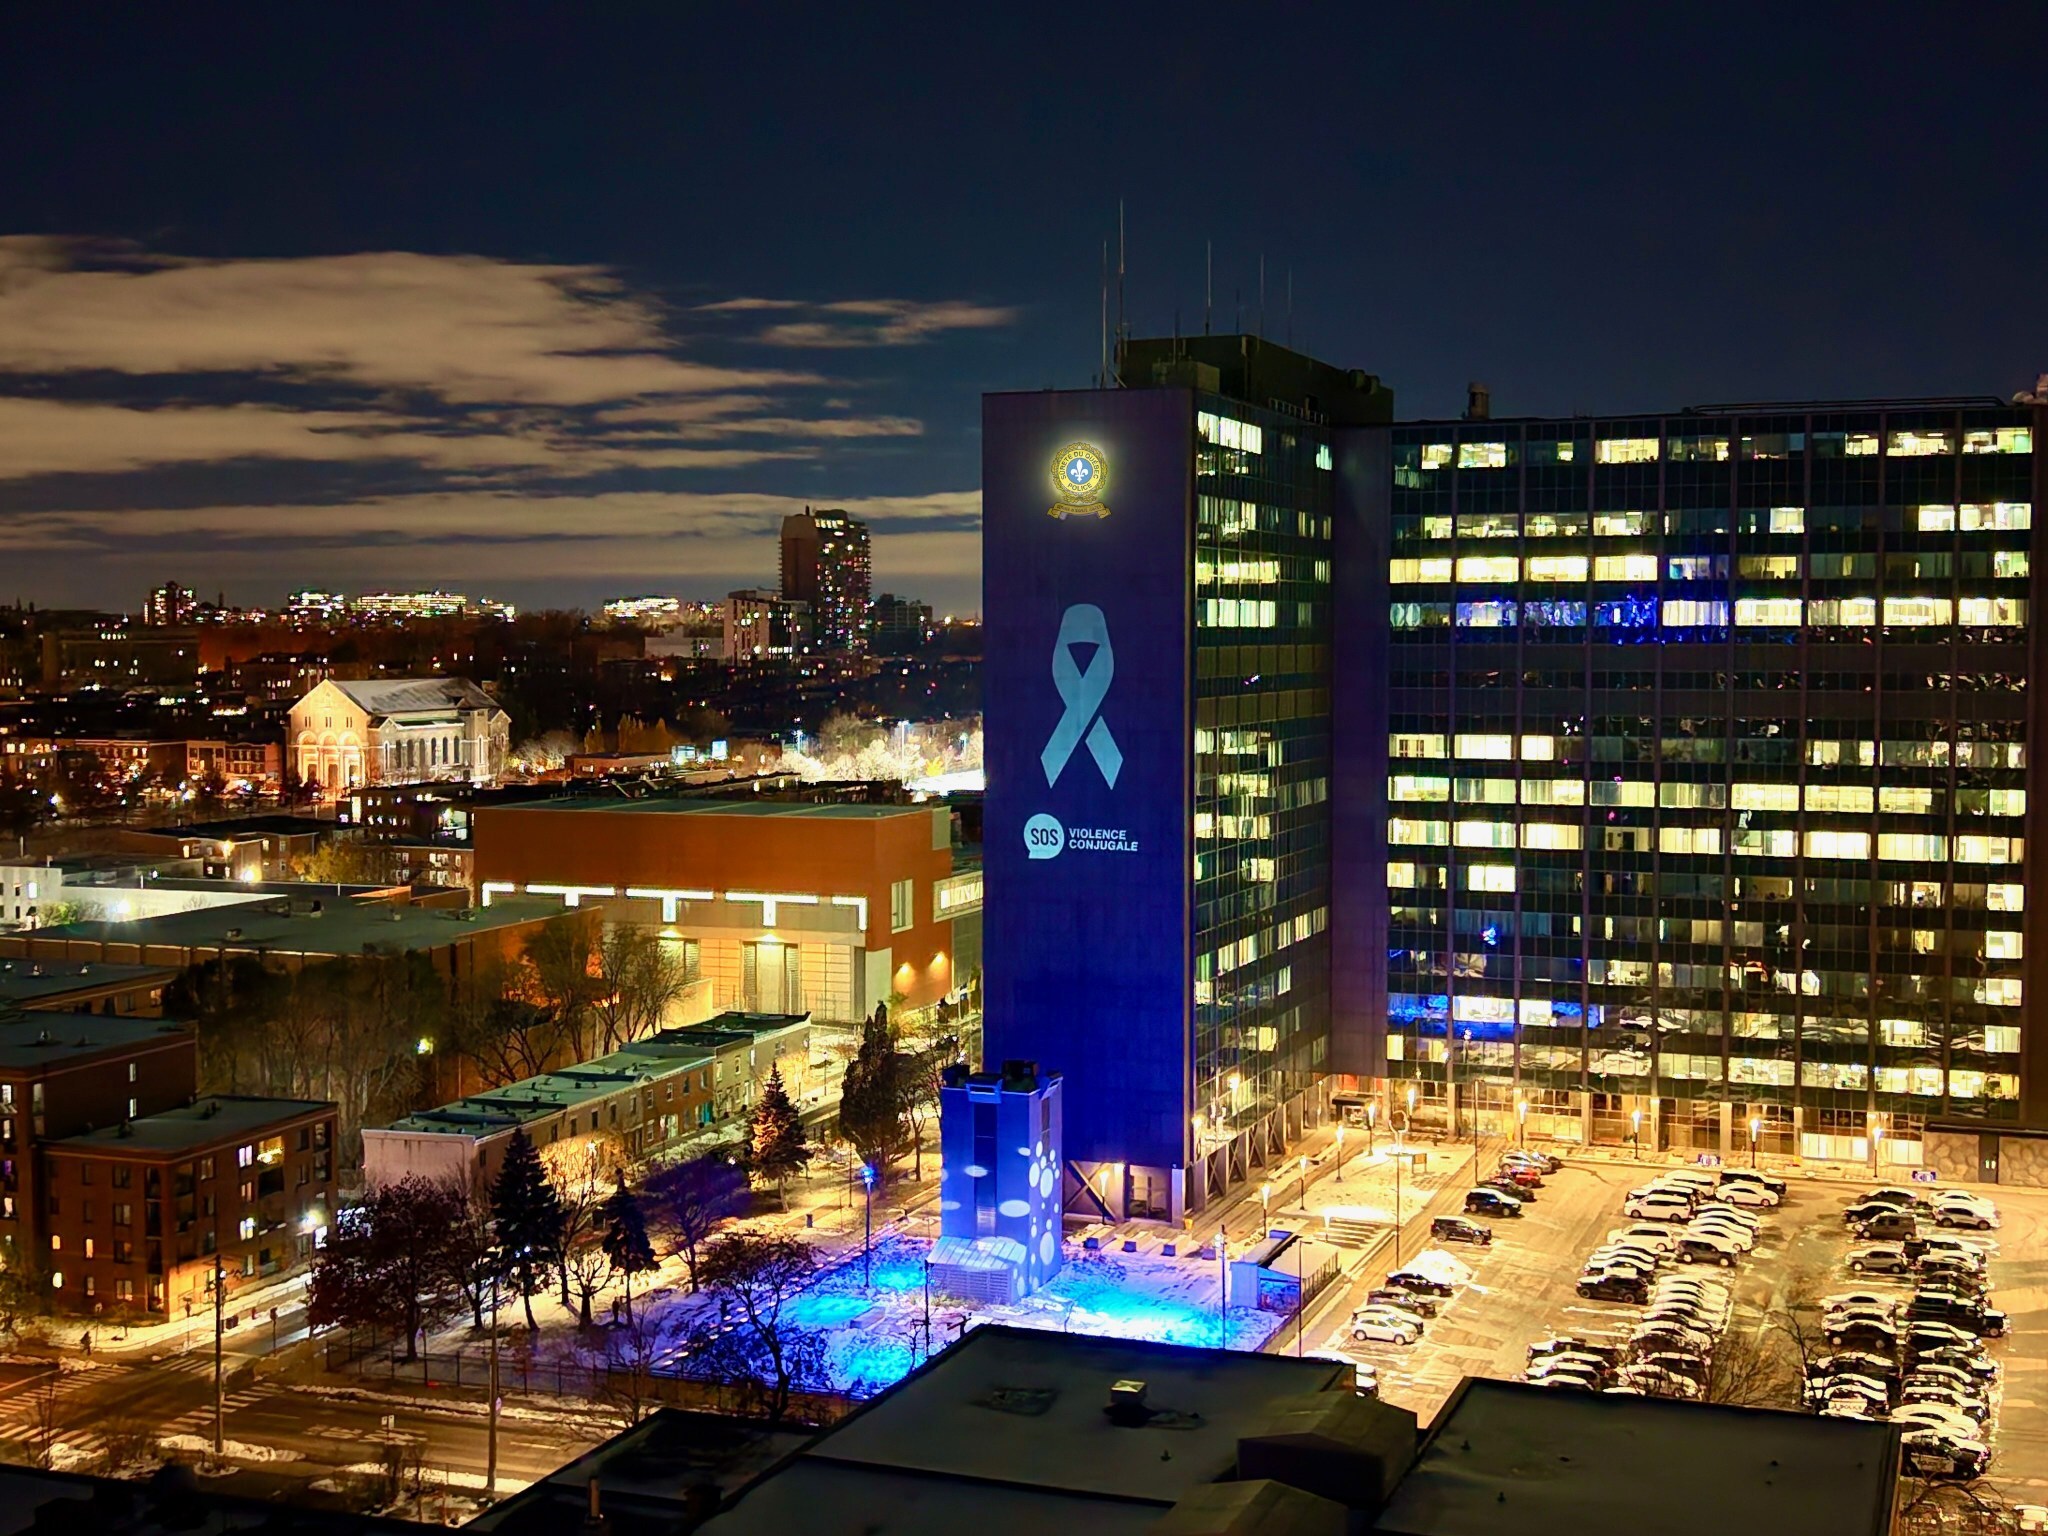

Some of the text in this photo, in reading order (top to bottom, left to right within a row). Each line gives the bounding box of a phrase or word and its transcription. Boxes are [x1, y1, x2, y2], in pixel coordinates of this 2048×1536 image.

[1067, 482, 1093, 491] POLICE
[1031, 827, 1059, 846] SOS
[1069, 828, 1127, 840] VIOLENCE
[1069, 839, 1139, 851] CONJUGALE
